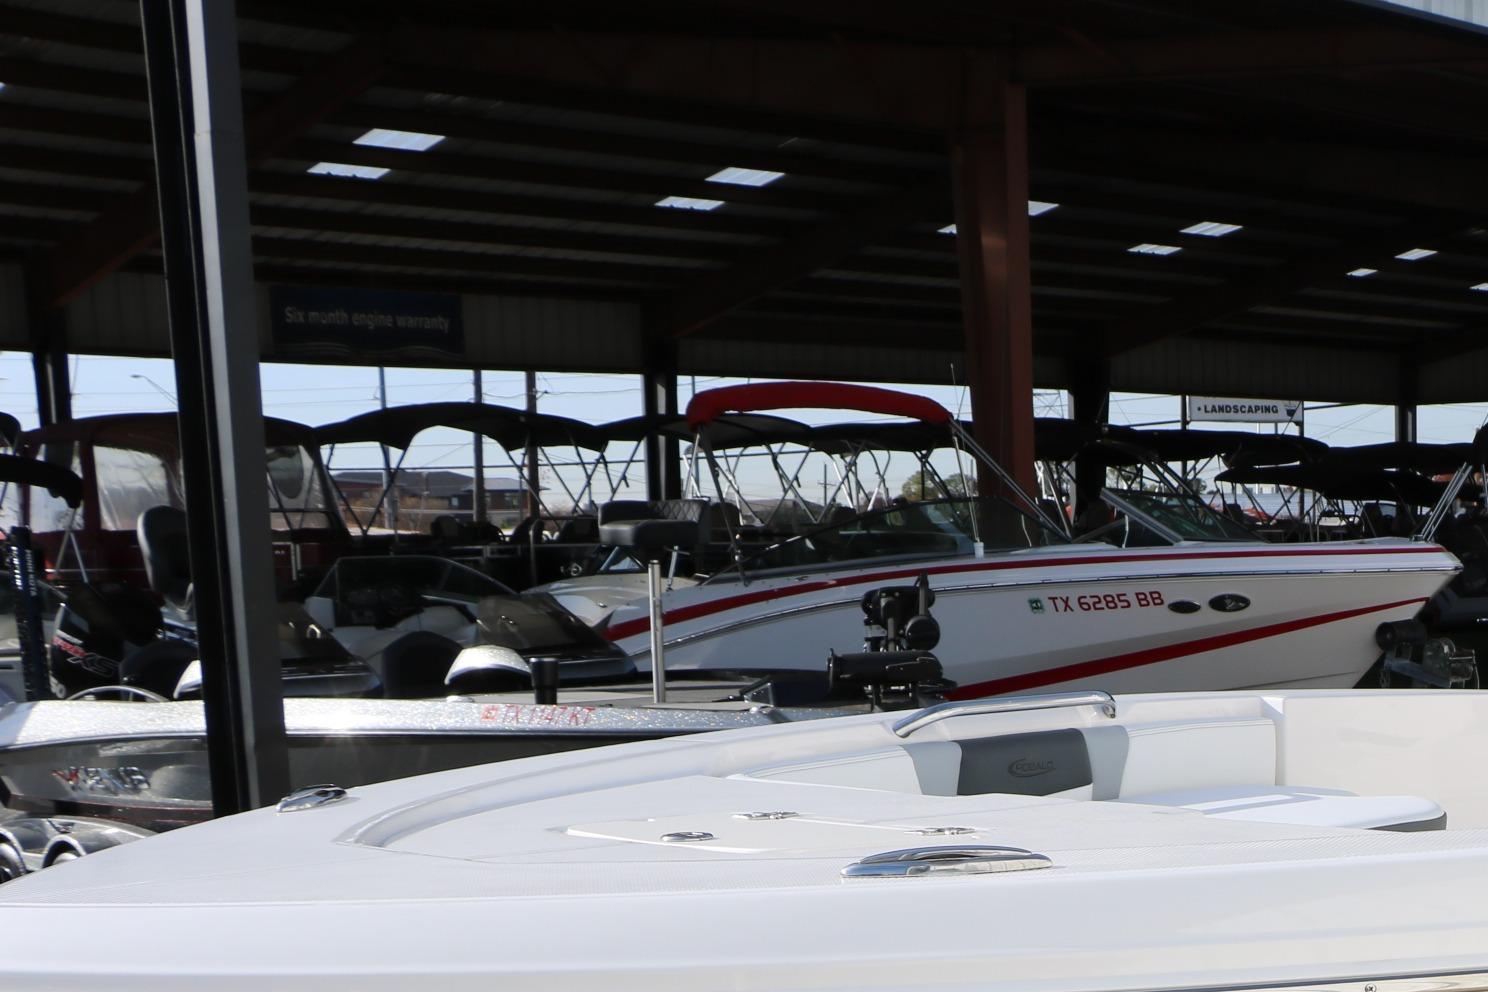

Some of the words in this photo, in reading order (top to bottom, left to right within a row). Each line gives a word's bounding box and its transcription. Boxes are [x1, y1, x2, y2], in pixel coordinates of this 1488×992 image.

[283, 306, 305, 324] Six
[308, 307, 349, 325] month
[351, 309, 393, 330] engine
[396, 314, 451, 334] warranty
[1204, 404, 1279, 414] LANDSCAPING
[1048, 596, 1074, 612] TX
[1077, 593, 1131, 612] 6285
[1135, 590, 1164, 608] BB
